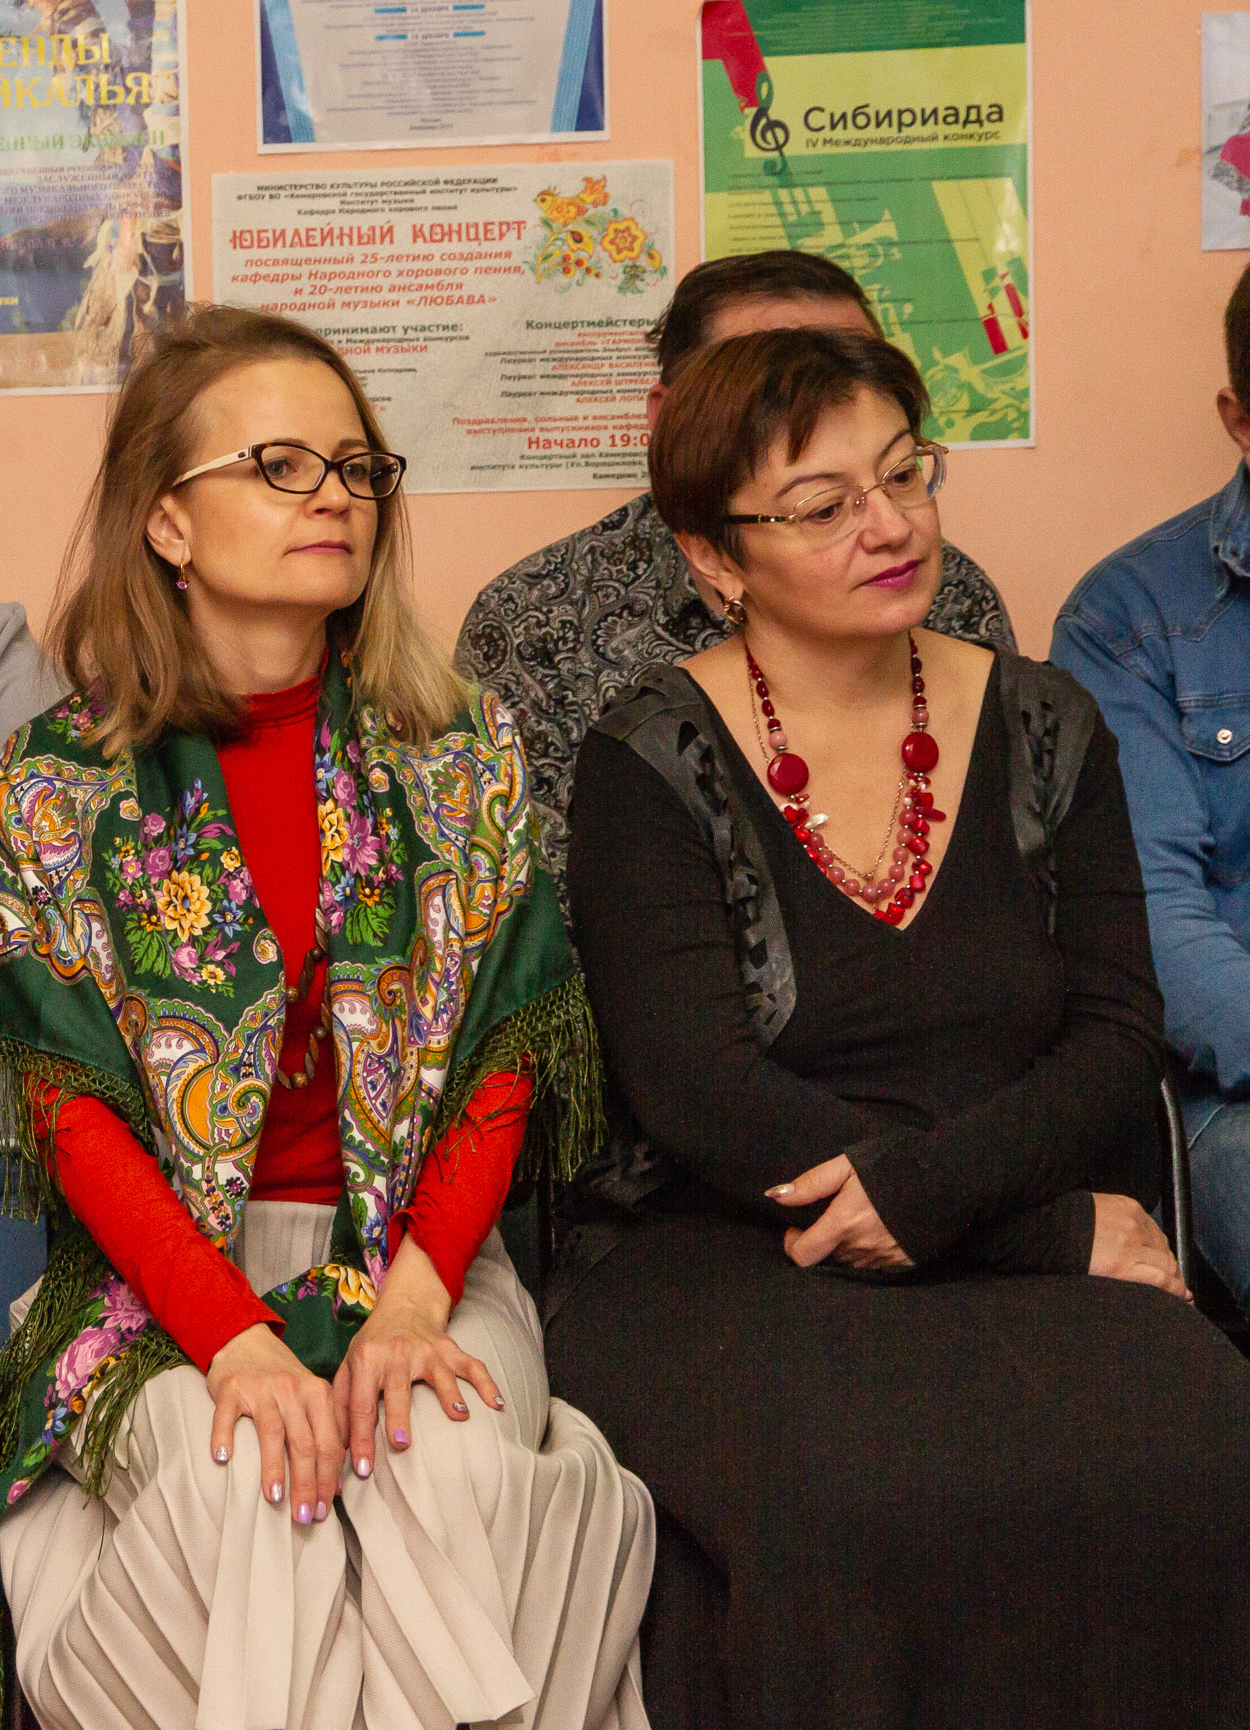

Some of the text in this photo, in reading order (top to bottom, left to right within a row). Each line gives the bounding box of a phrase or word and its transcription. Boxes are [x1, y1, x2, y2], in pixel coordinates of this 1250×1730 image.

[803, 103, 1005, 133] Сибириада
[806, 129, 1001, 149] IV Международный конкурс
[256, 182, 328, 191] МИНИСТЕРСТВО
[329, 181, 378, 190] КУЛЬТУРЫ
[380, 178, 441, 188] РОССИЙСКОЙ
[229, 220, 527, 250] ЮБИЛЕЙНЫЙ КОНЦЕРТ
[244, 249, 513, 268] посвященный 25-летию создания
[231, 264, 526, 285] кафедры Народного хорового пения,
[293, 280, 465, 296] и 20-летию ансамбля
[261, 294, 498, 313] народной музыки «ЛЮБАВА»
[402, 323, 464, 336] участие:
[375, 343, 428, 354] МУЗЫКИ
[527, 433, 651, 450] Начало 19:0
